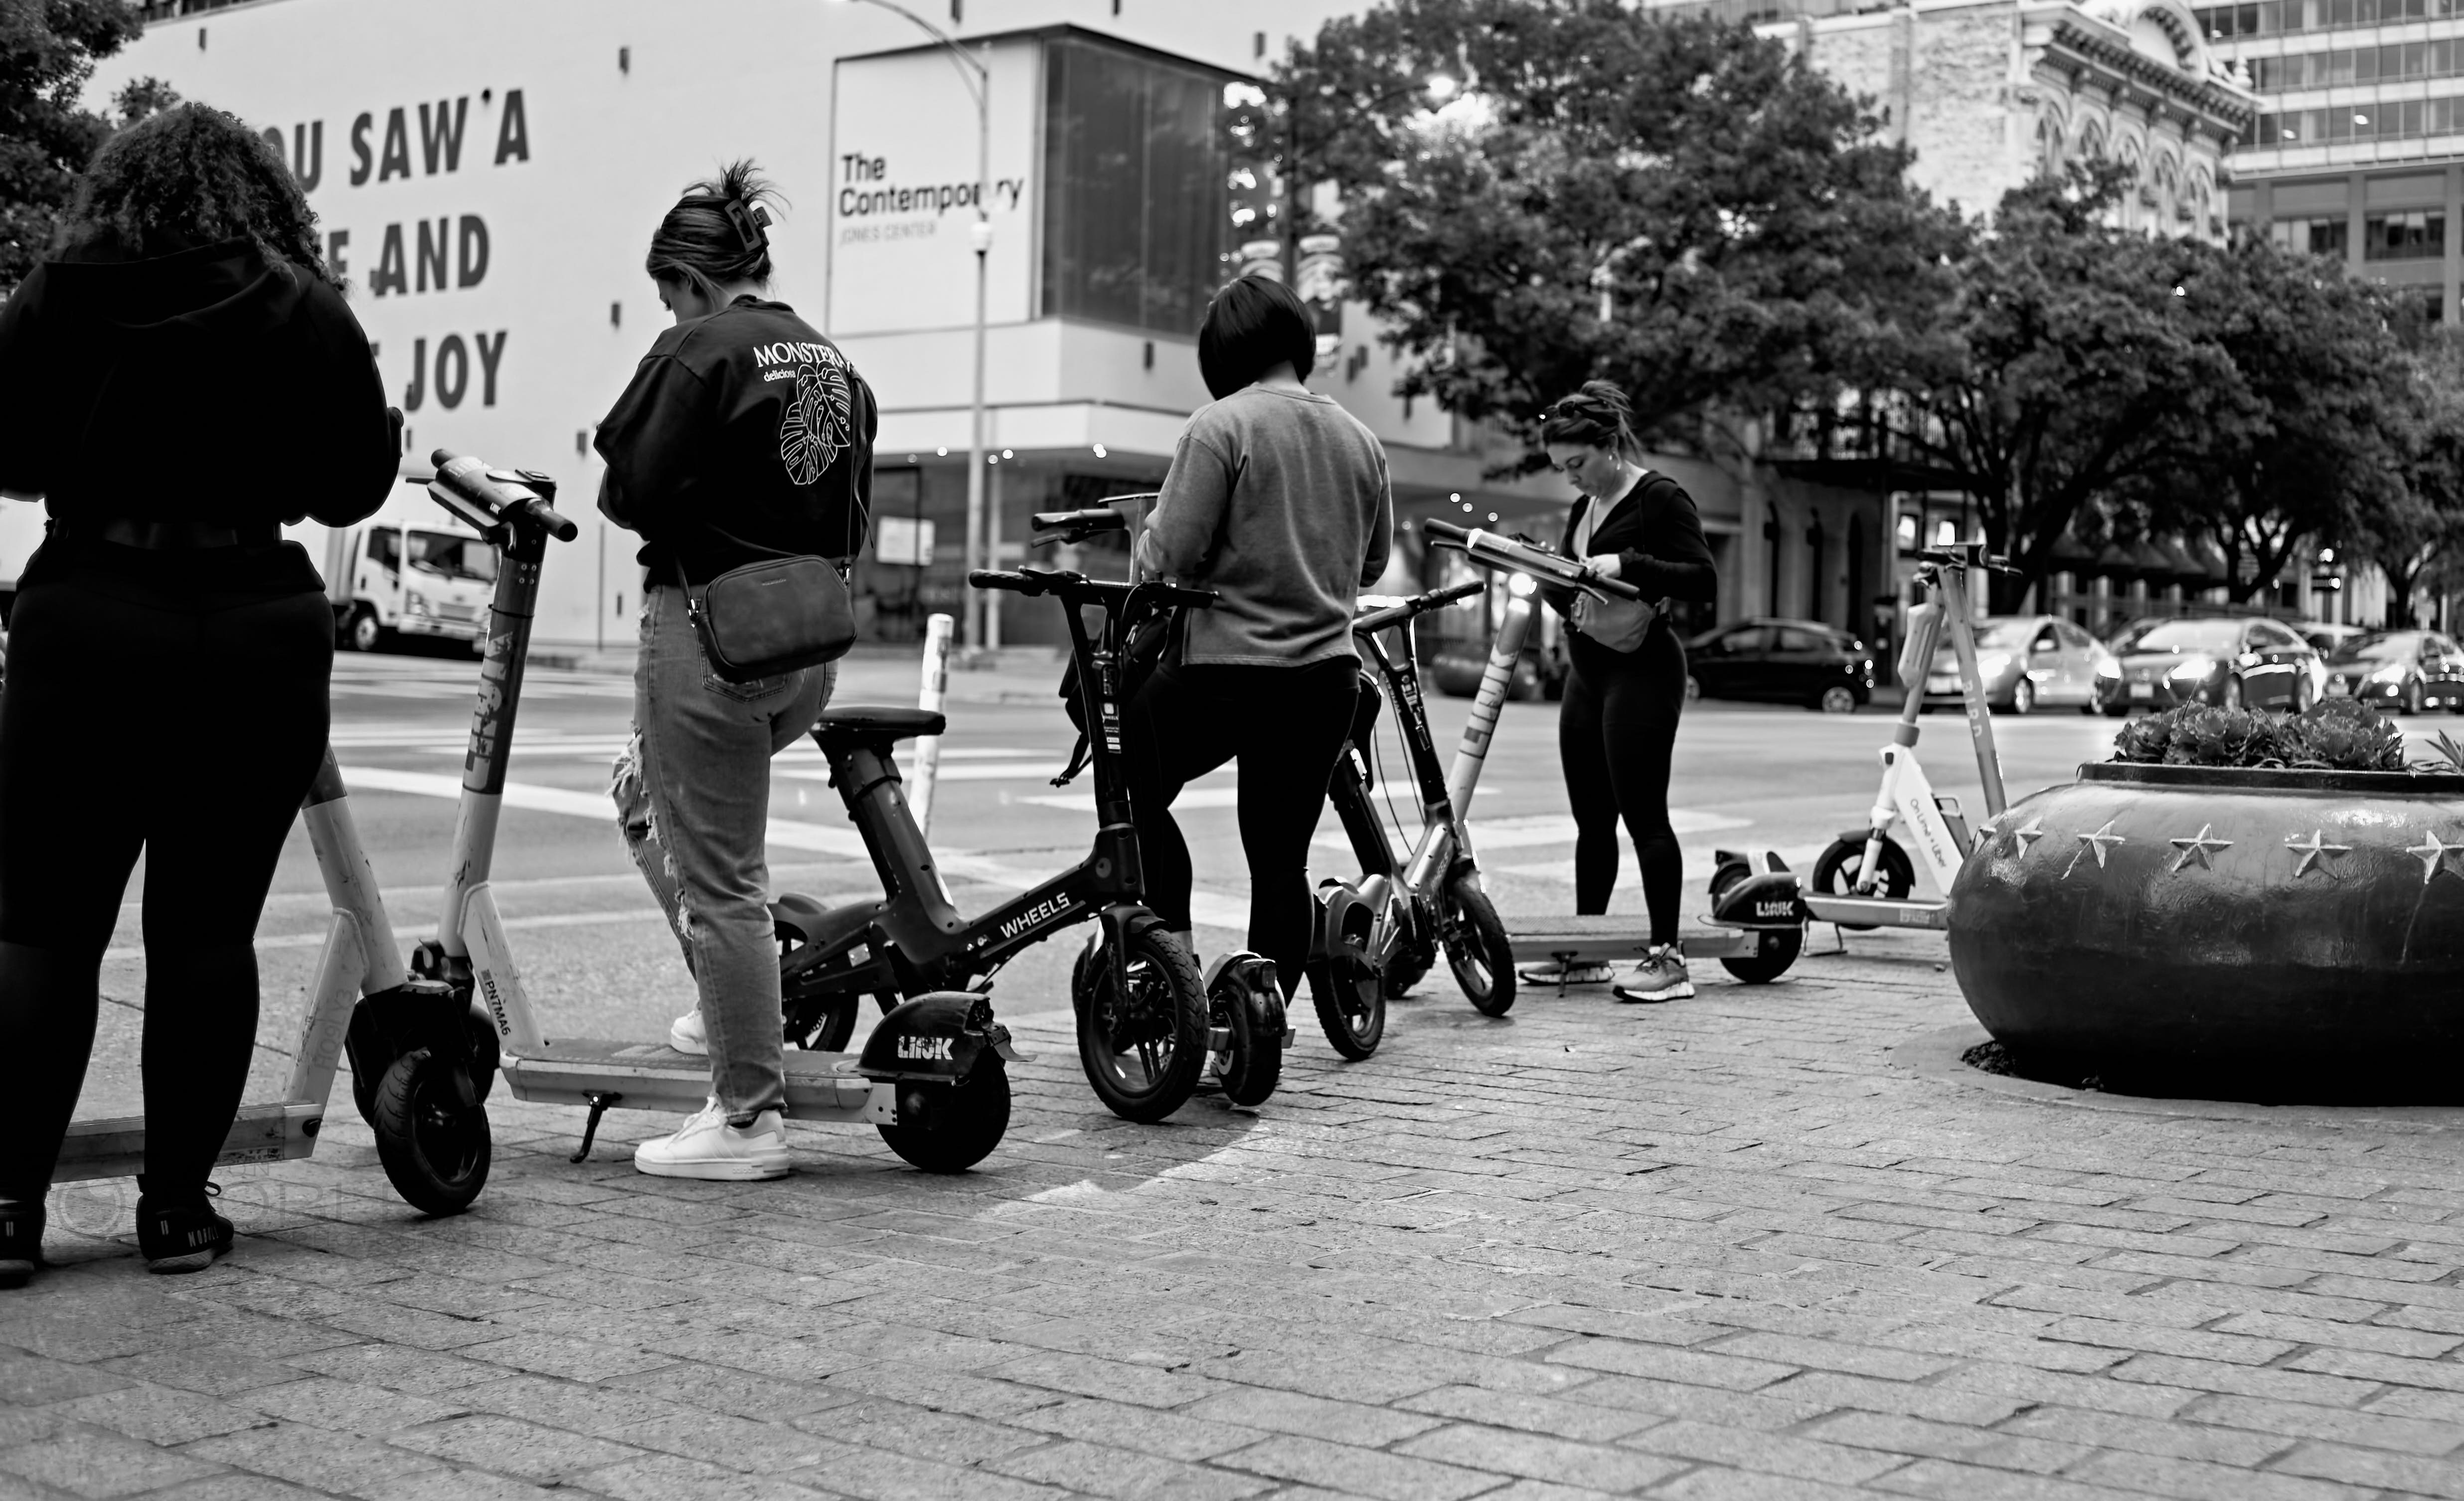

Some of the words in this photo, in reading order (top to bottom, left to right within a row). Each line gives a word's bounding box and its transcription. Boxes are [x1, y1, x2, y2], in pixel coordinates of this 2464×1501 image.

[349, 96, 470, 187] SAW
[493, 89, 530, 166] A
[841, 151, 887, 182] The
[839, 177, 1025, 217] Contemporry
[374, 213, 490, 298] AND
[404, 330, 508, 412] JOY
[753, 341, 843, 368] MONSTERA
[763, 369, 796, 382] deliciosa
[999, 891, 1070, 939] WHEELS
[311, 988, 353, 1071] HQ9LY3
[485, 980, 511, 1037] PN7MA6
